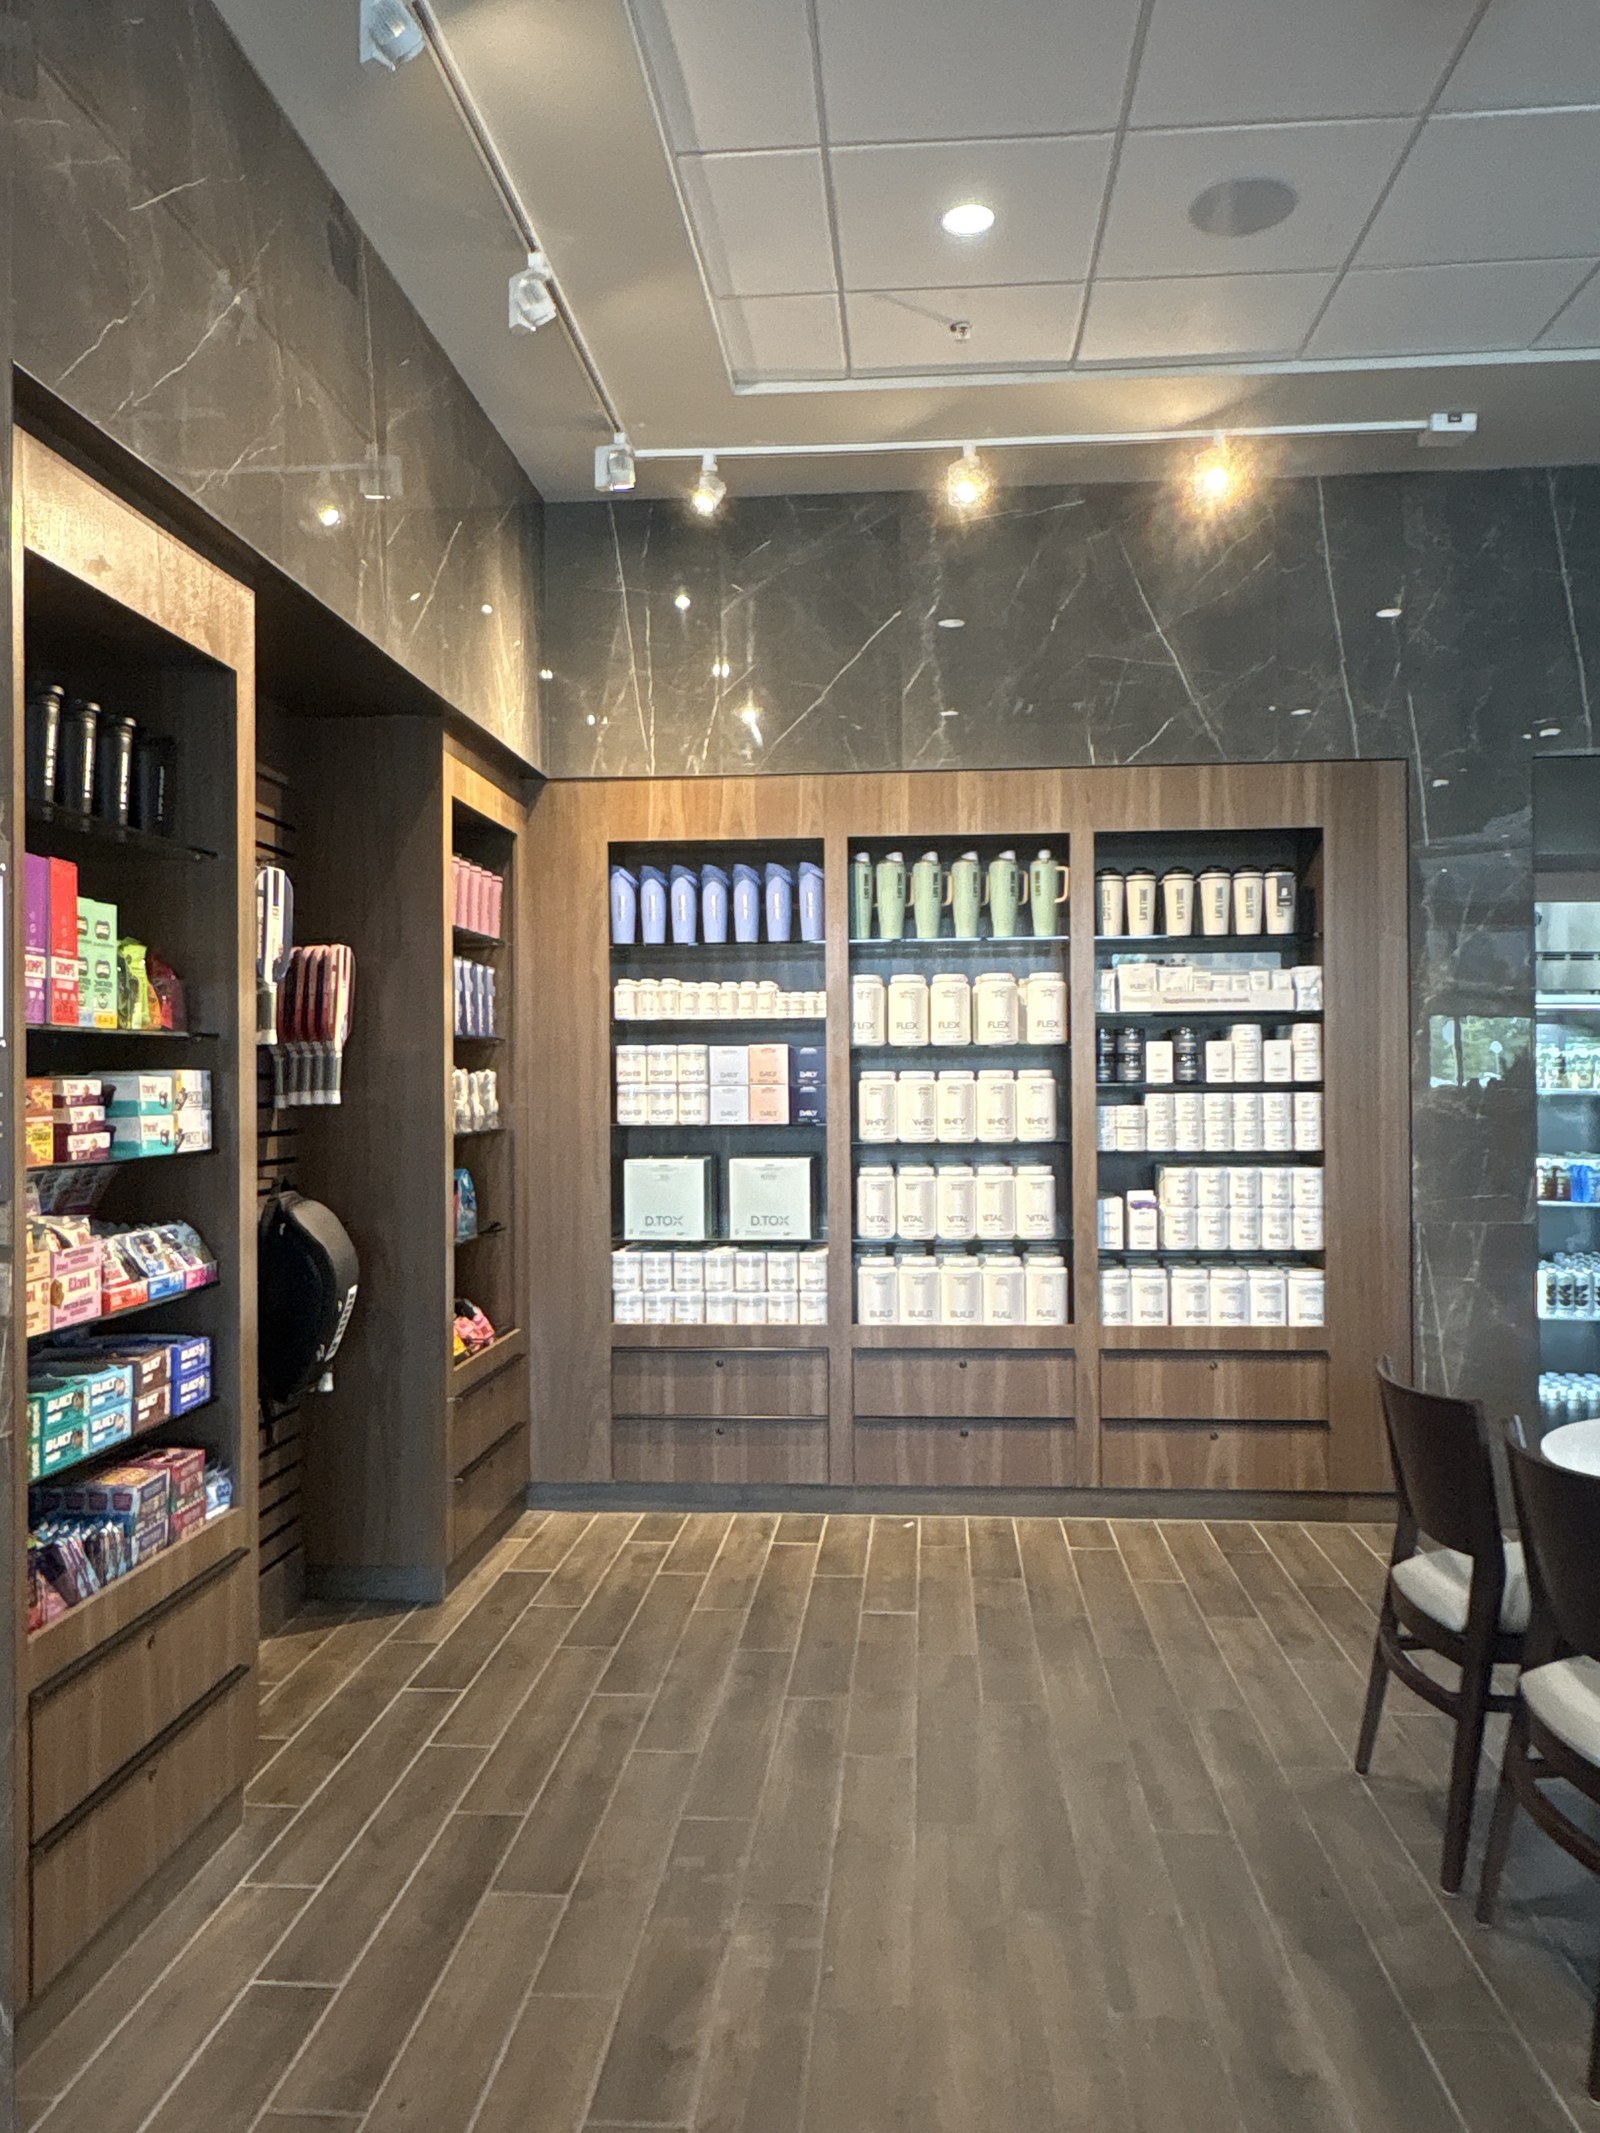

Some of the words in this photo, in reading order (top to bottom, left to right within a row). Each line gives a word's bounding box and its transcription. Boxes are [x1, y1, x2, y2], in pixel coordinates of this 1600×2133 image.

[853, 1022, 876, 1030] FLEX
[896, 1022, 919, 1030] FLEX
[938, 1021, 961, 1029] FLEX
[987, 1021, 1010, 1029] FLEX
[1037, 1020, 1060, 1028] FLEX
[644, 1215, 683, 1226] D.TOX
[751, 1215, 790, 1226] D.TOX
